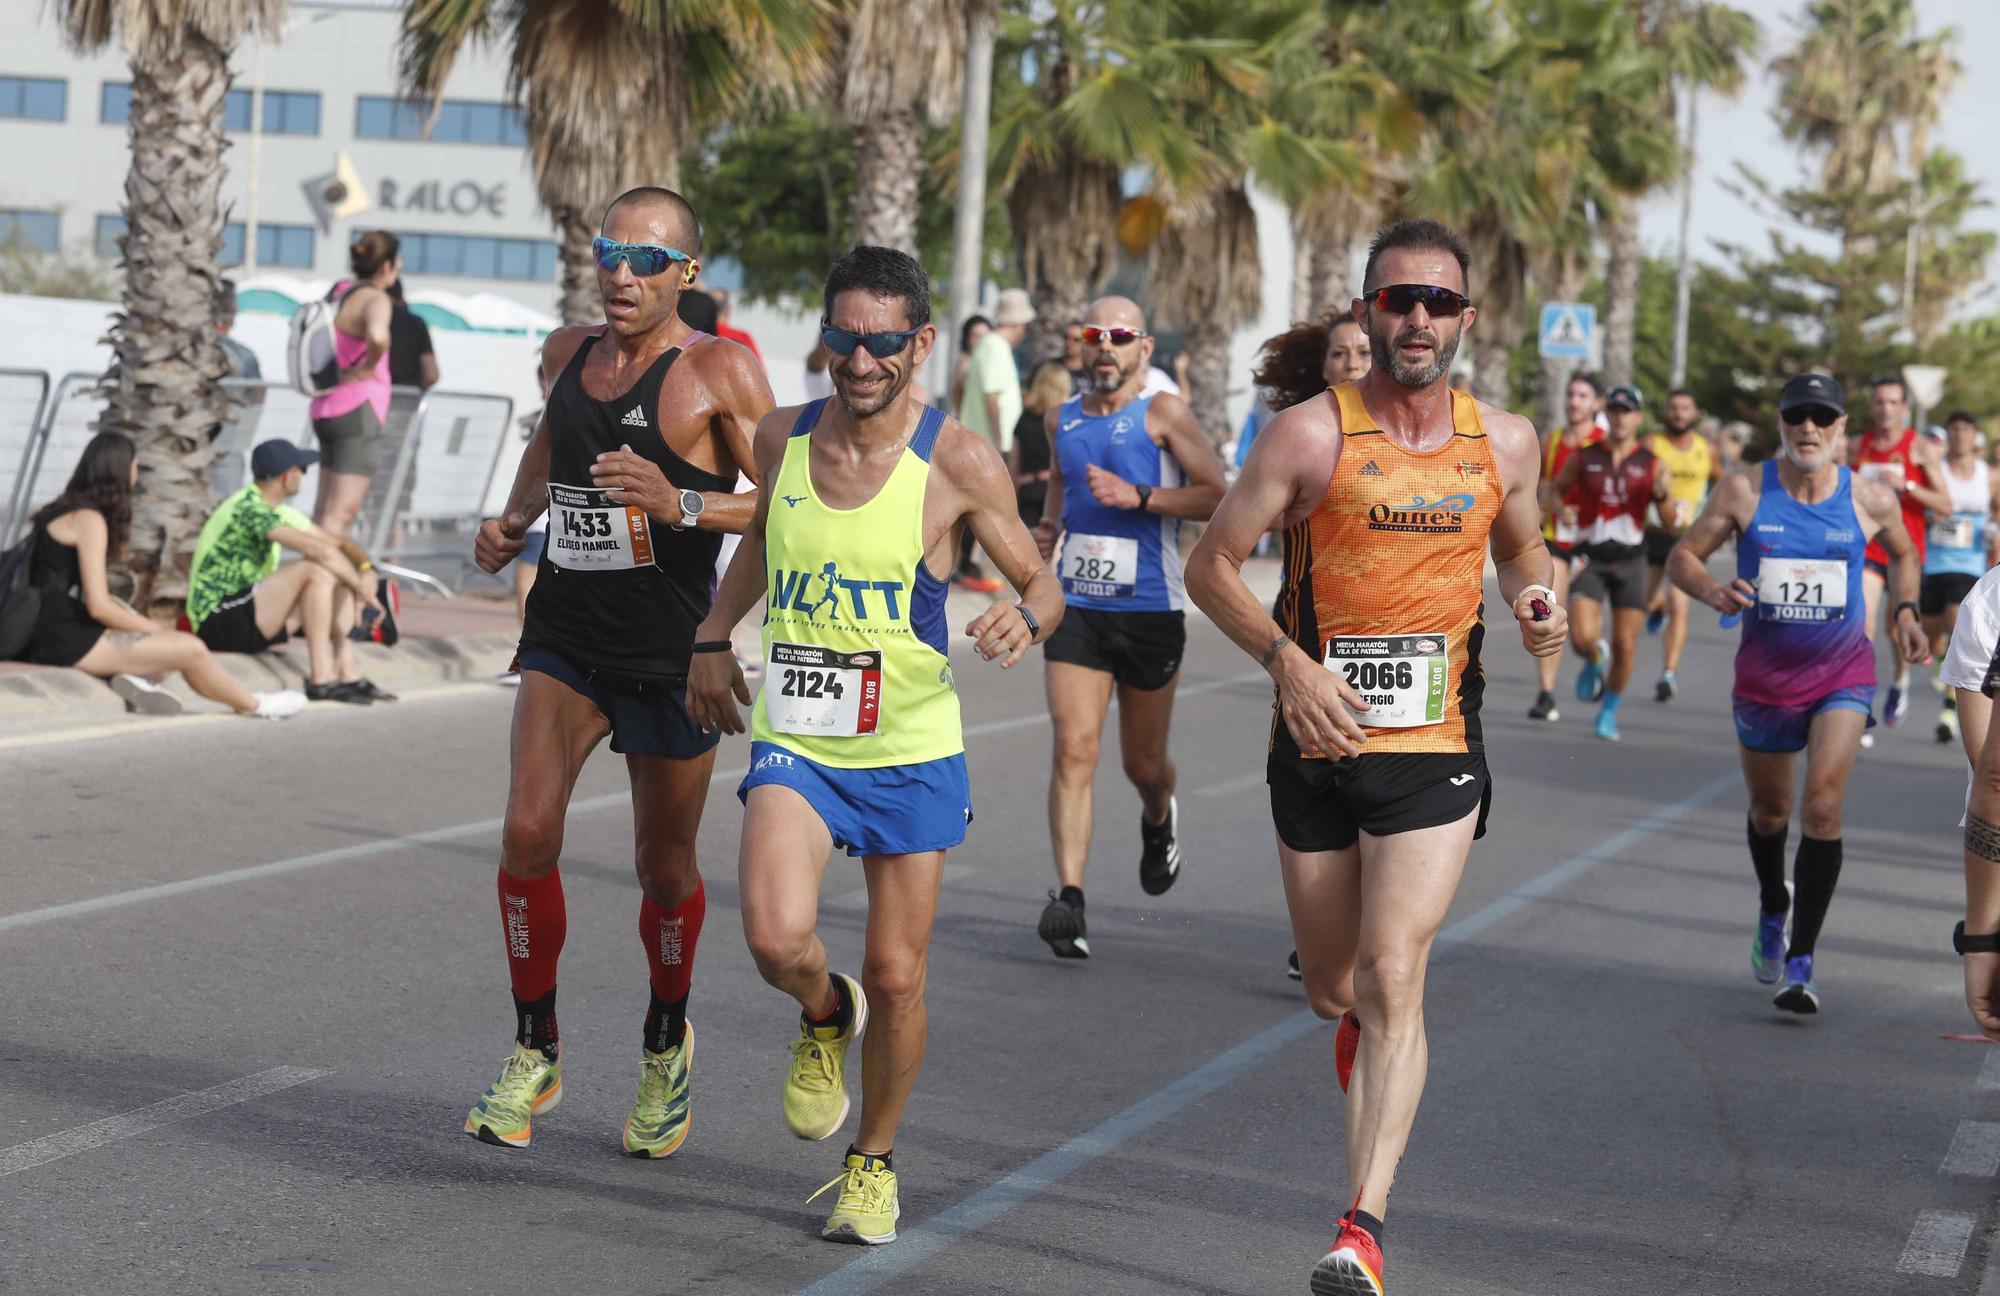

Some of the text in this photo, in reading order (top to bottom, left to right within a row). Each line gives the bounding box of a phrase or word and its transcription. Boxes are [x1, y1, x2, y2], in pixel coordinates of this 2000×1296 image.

[379, 179, 508, 218] RALOE
[621, 417, 648, 428] adidas
[561, 510, 612, 538] 1433
[631, 515, 643, 534] BOX
[557, 538, 620, 552] ELISEO MANUEL
[1074, 556, 1116, 581] 282
[1779, 582, 1823, 604] 121
[832, 625, 878, 634] TRAINING
[777, 647, 823, 658] MEDIA MARATÓN
[1336, 640, 1388, 649] MEDIA MARATÓN
[777, 653, 789, 661] VILA
[796, 656, 824, 664] PATERNA
[781, 669, 844, 700] 2124
[1342, 661, 1413, 691] 2066
[1432, 667, 1443, 686] BOX
[865, 681, 877, 700] BOX
[1359, 694, 1395, 705] ERGIO
[517, 923, 530, 959] SPORT
[671, 938, 682, 965] SPORT
